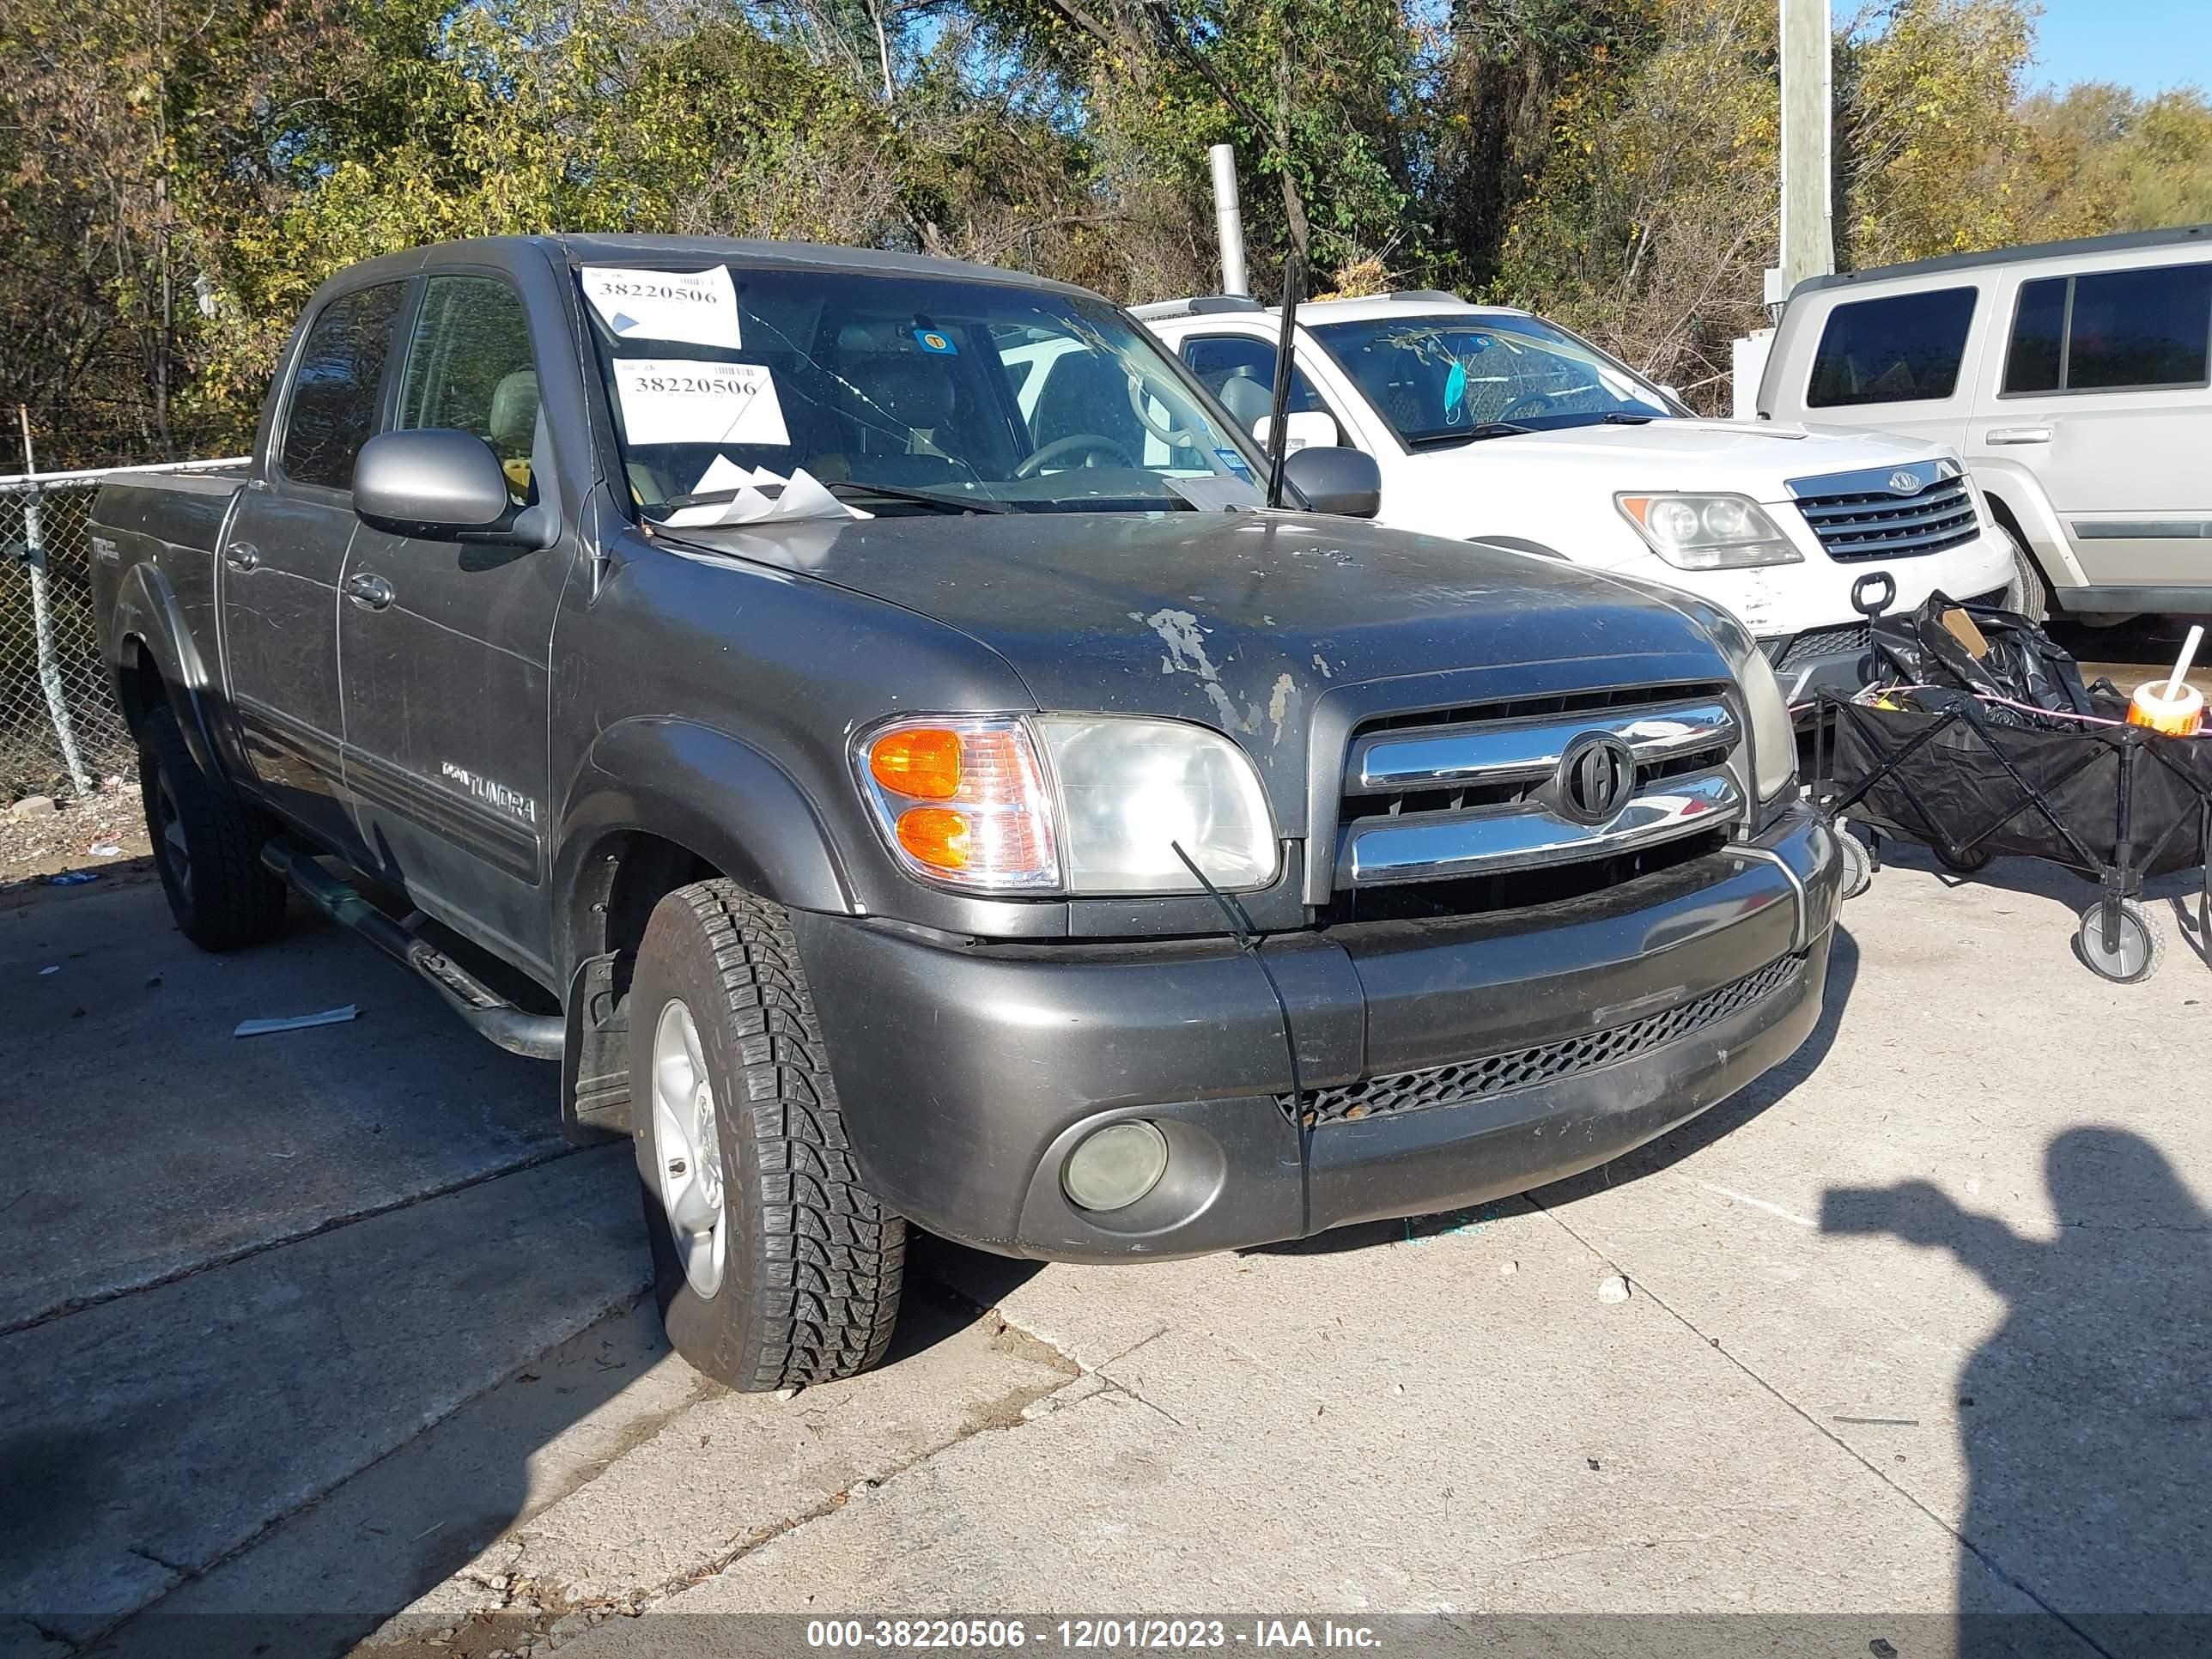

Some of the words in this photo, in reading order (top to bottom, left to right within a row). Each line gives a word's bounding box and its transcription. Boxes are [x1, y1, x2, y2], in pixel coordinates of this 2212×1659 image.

[599, 283, 717, 304] 38220506
[635, 378, 757, 396] 38220506
[469, 775, 536, 823] TUNDRA
